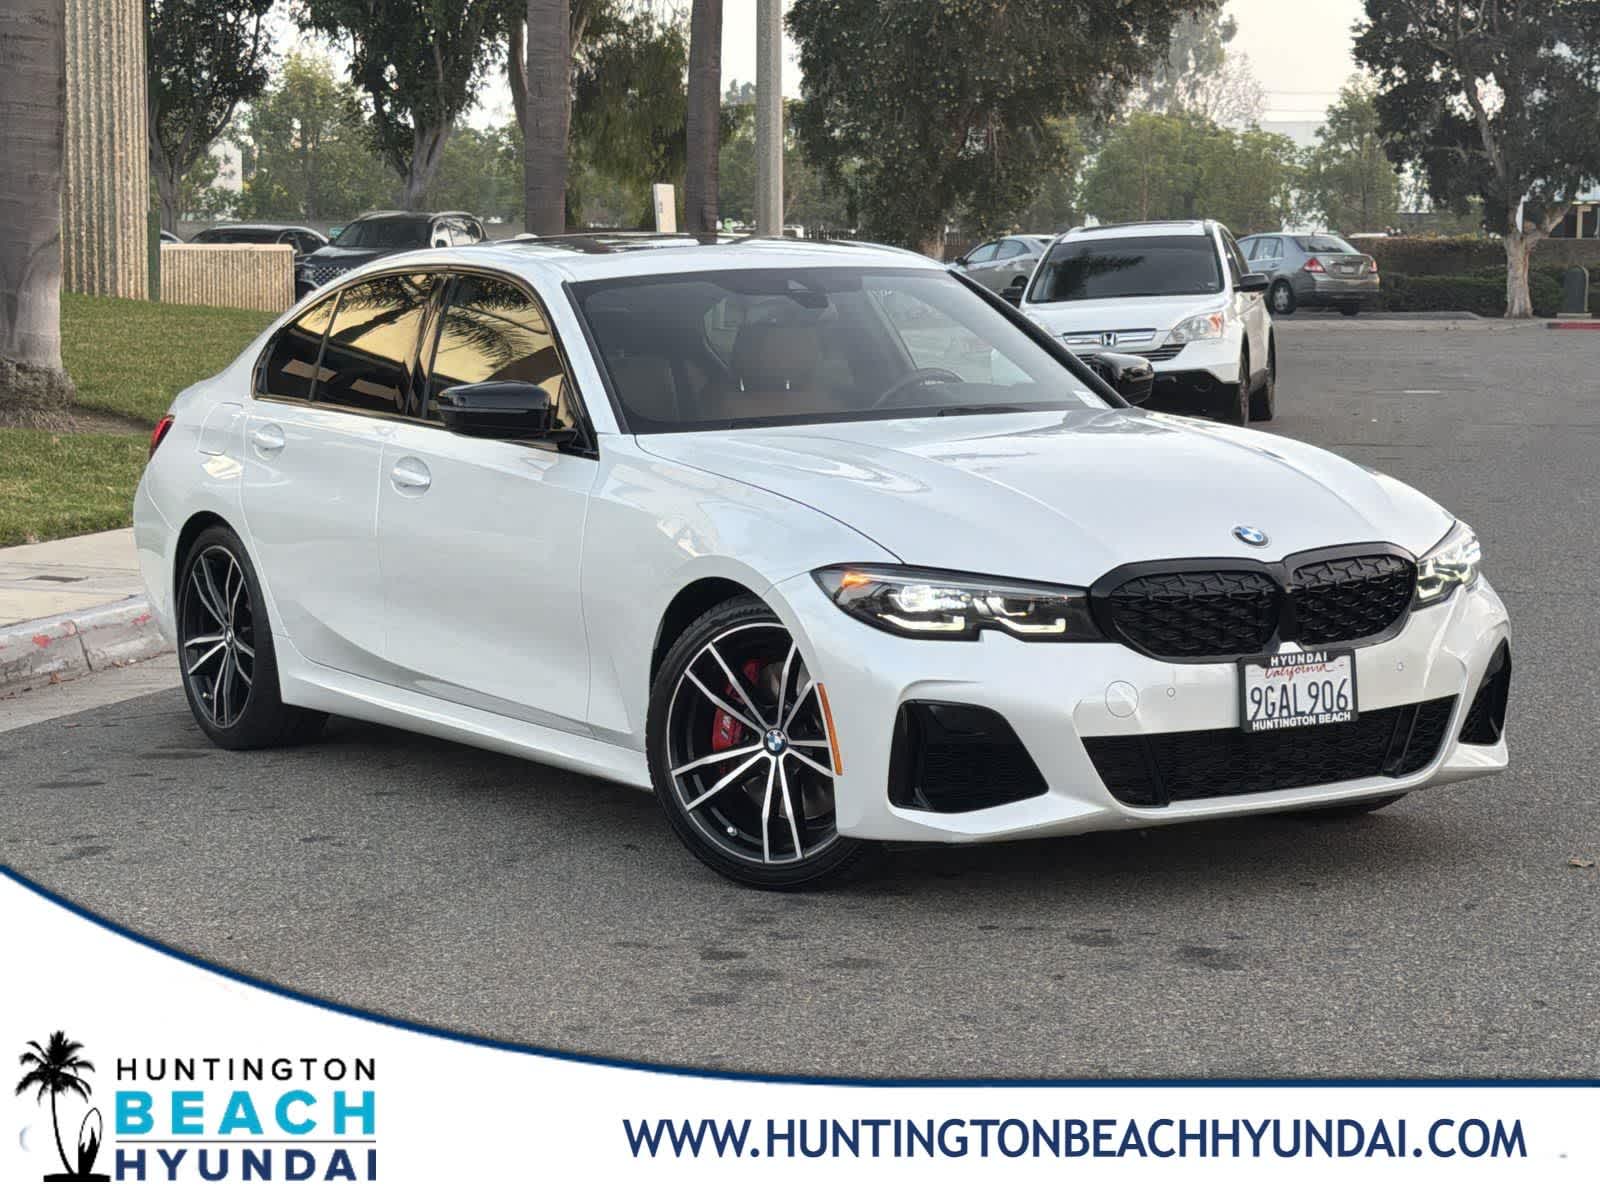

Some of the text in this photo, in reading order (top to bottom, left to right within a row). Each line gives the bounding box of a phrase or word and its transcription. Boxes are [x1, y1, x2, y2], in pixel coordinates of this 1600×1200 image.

[1271, 652, 1327, 666] HYUNDAI
[1265, 664, 1334, 681] California
[1250, 678, 1349, 721] 9GAL906
[1252, 711, 1351, 731] HUNTINGTON BEACH
